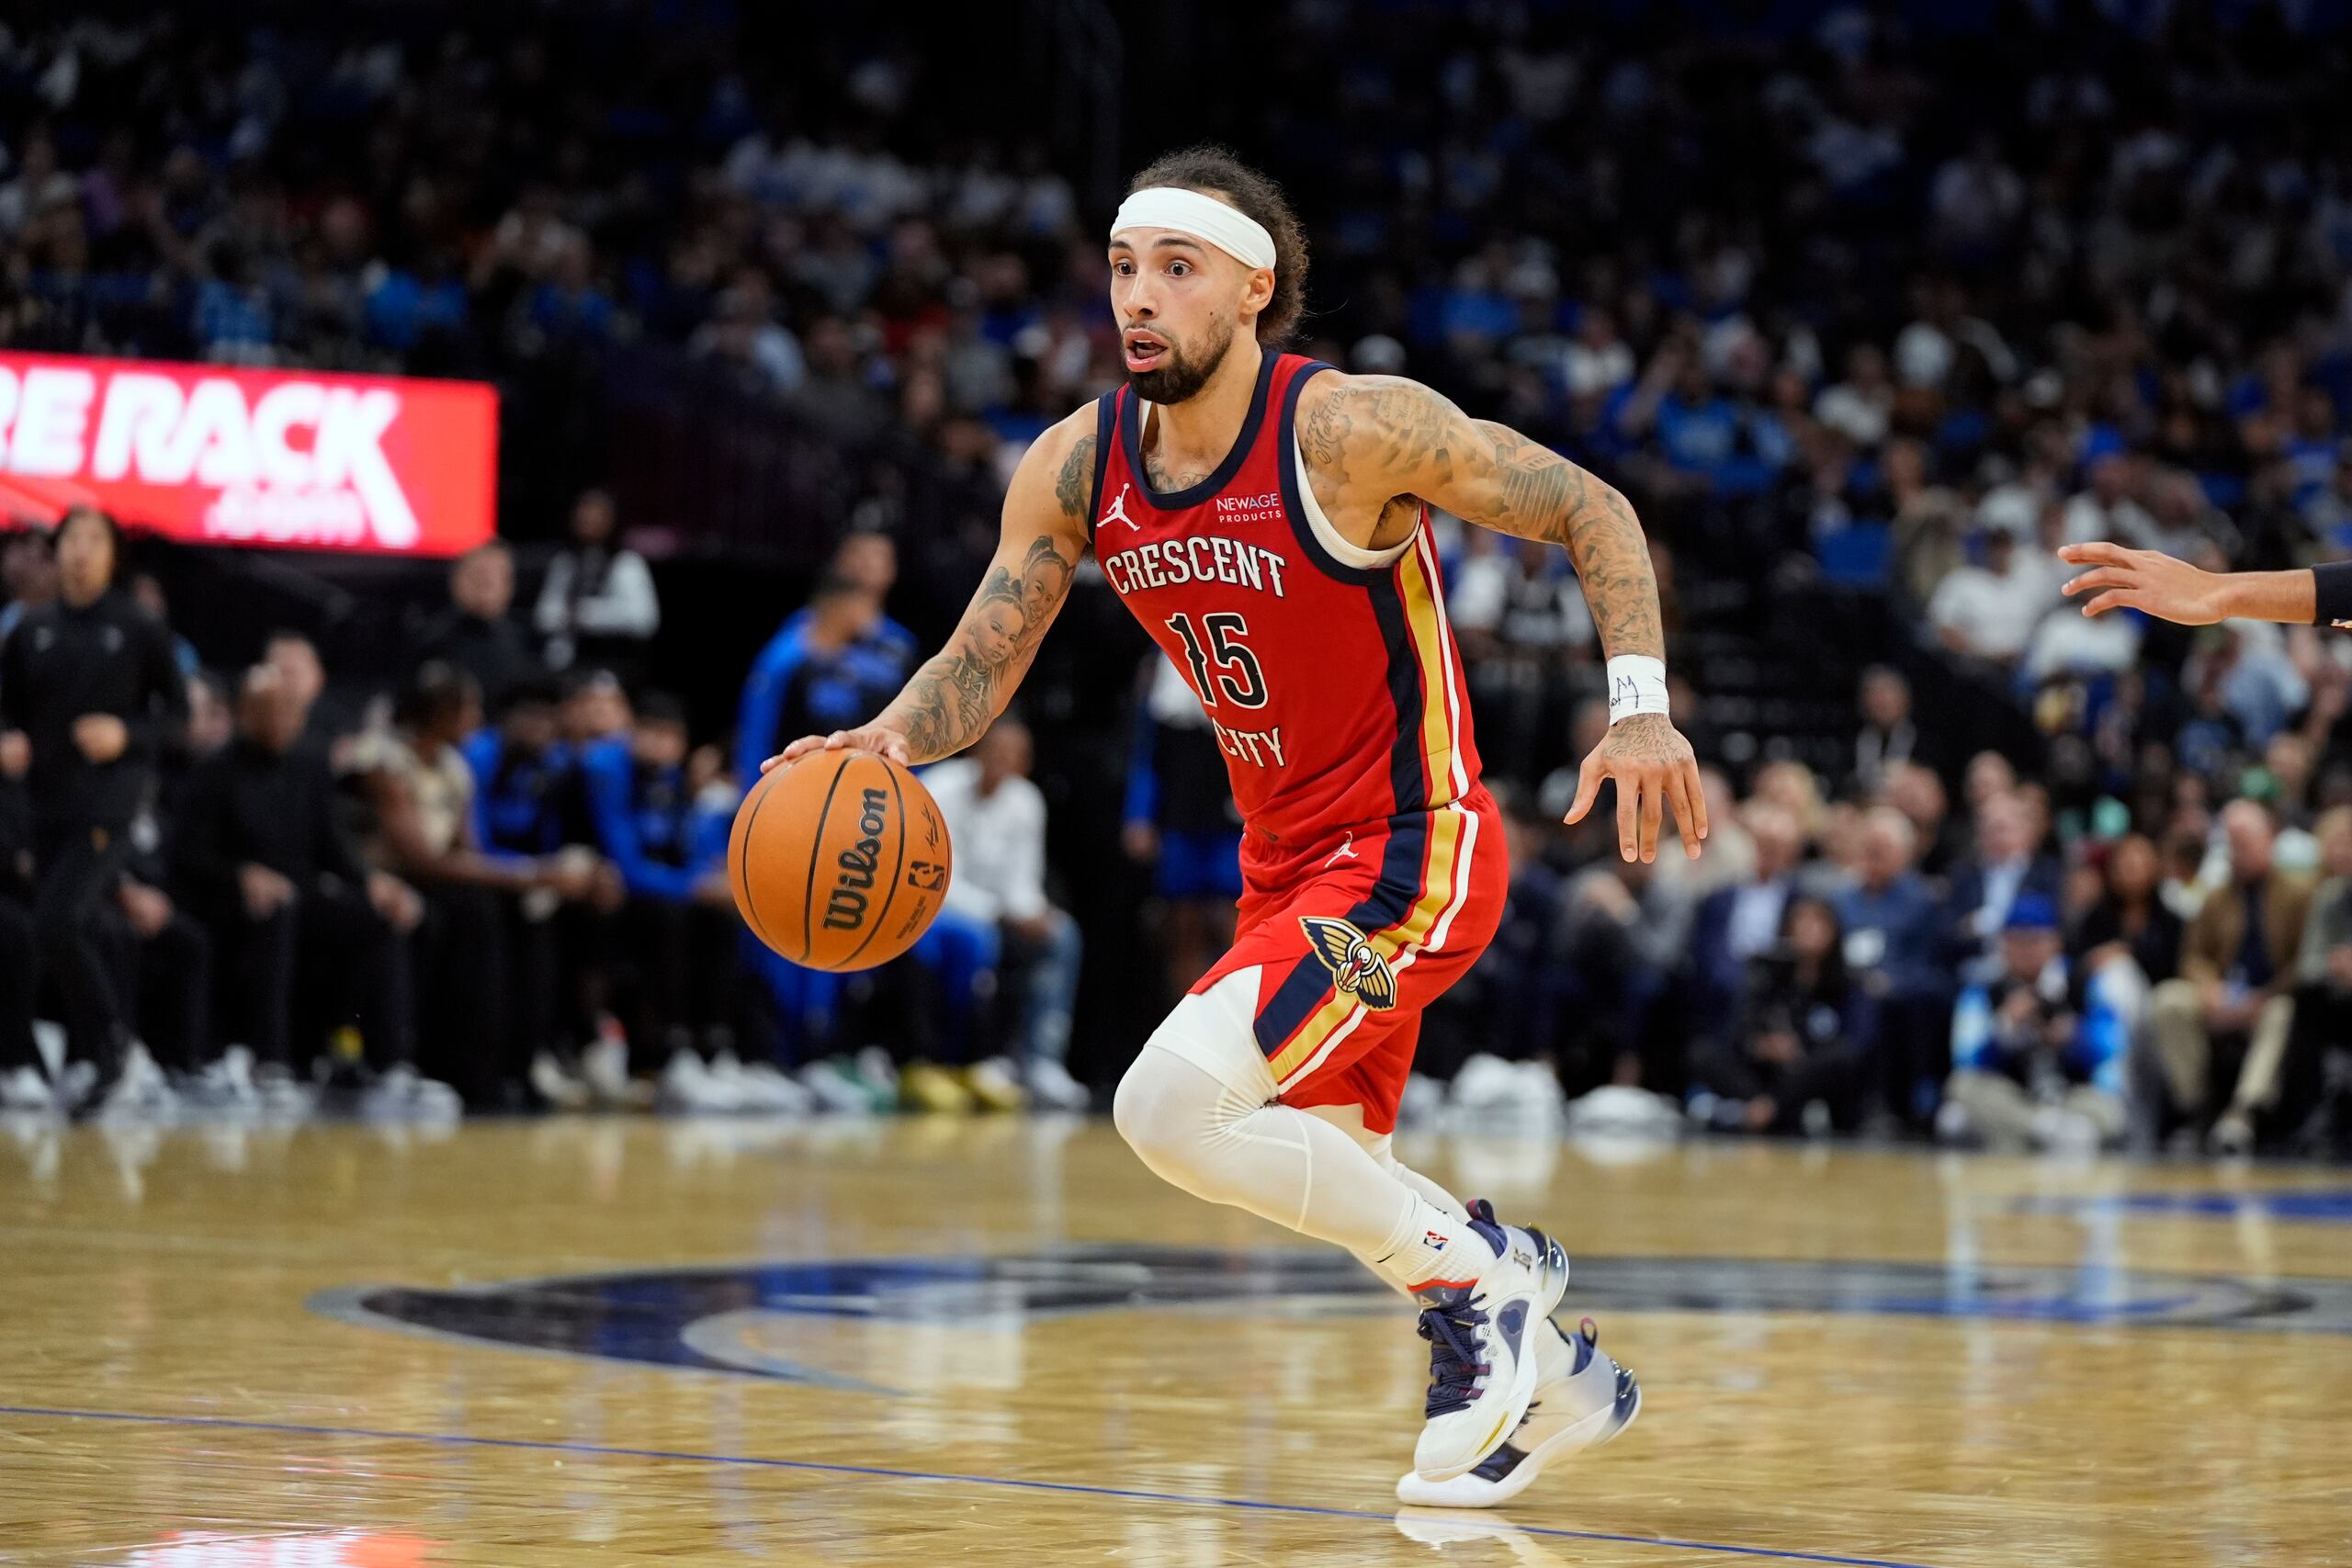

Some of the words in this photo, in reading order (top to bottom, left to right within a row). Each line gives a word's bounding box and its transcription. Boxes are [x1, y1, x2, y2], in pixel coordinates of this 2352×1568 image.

[0, 365, 95, 477] E
[94, 373, 420, 548] RACK
[1216, 492, 1281, 513] NEWAGE
[1218, 510, 1283, 524] PRODUCTS
[1104, 536, 1286, 599] CRESCENT
[1164, 612, 1270, 710] 15
[1211, 715, 1286, 768] CITY
[822, 787, 888, 931] Wilson
